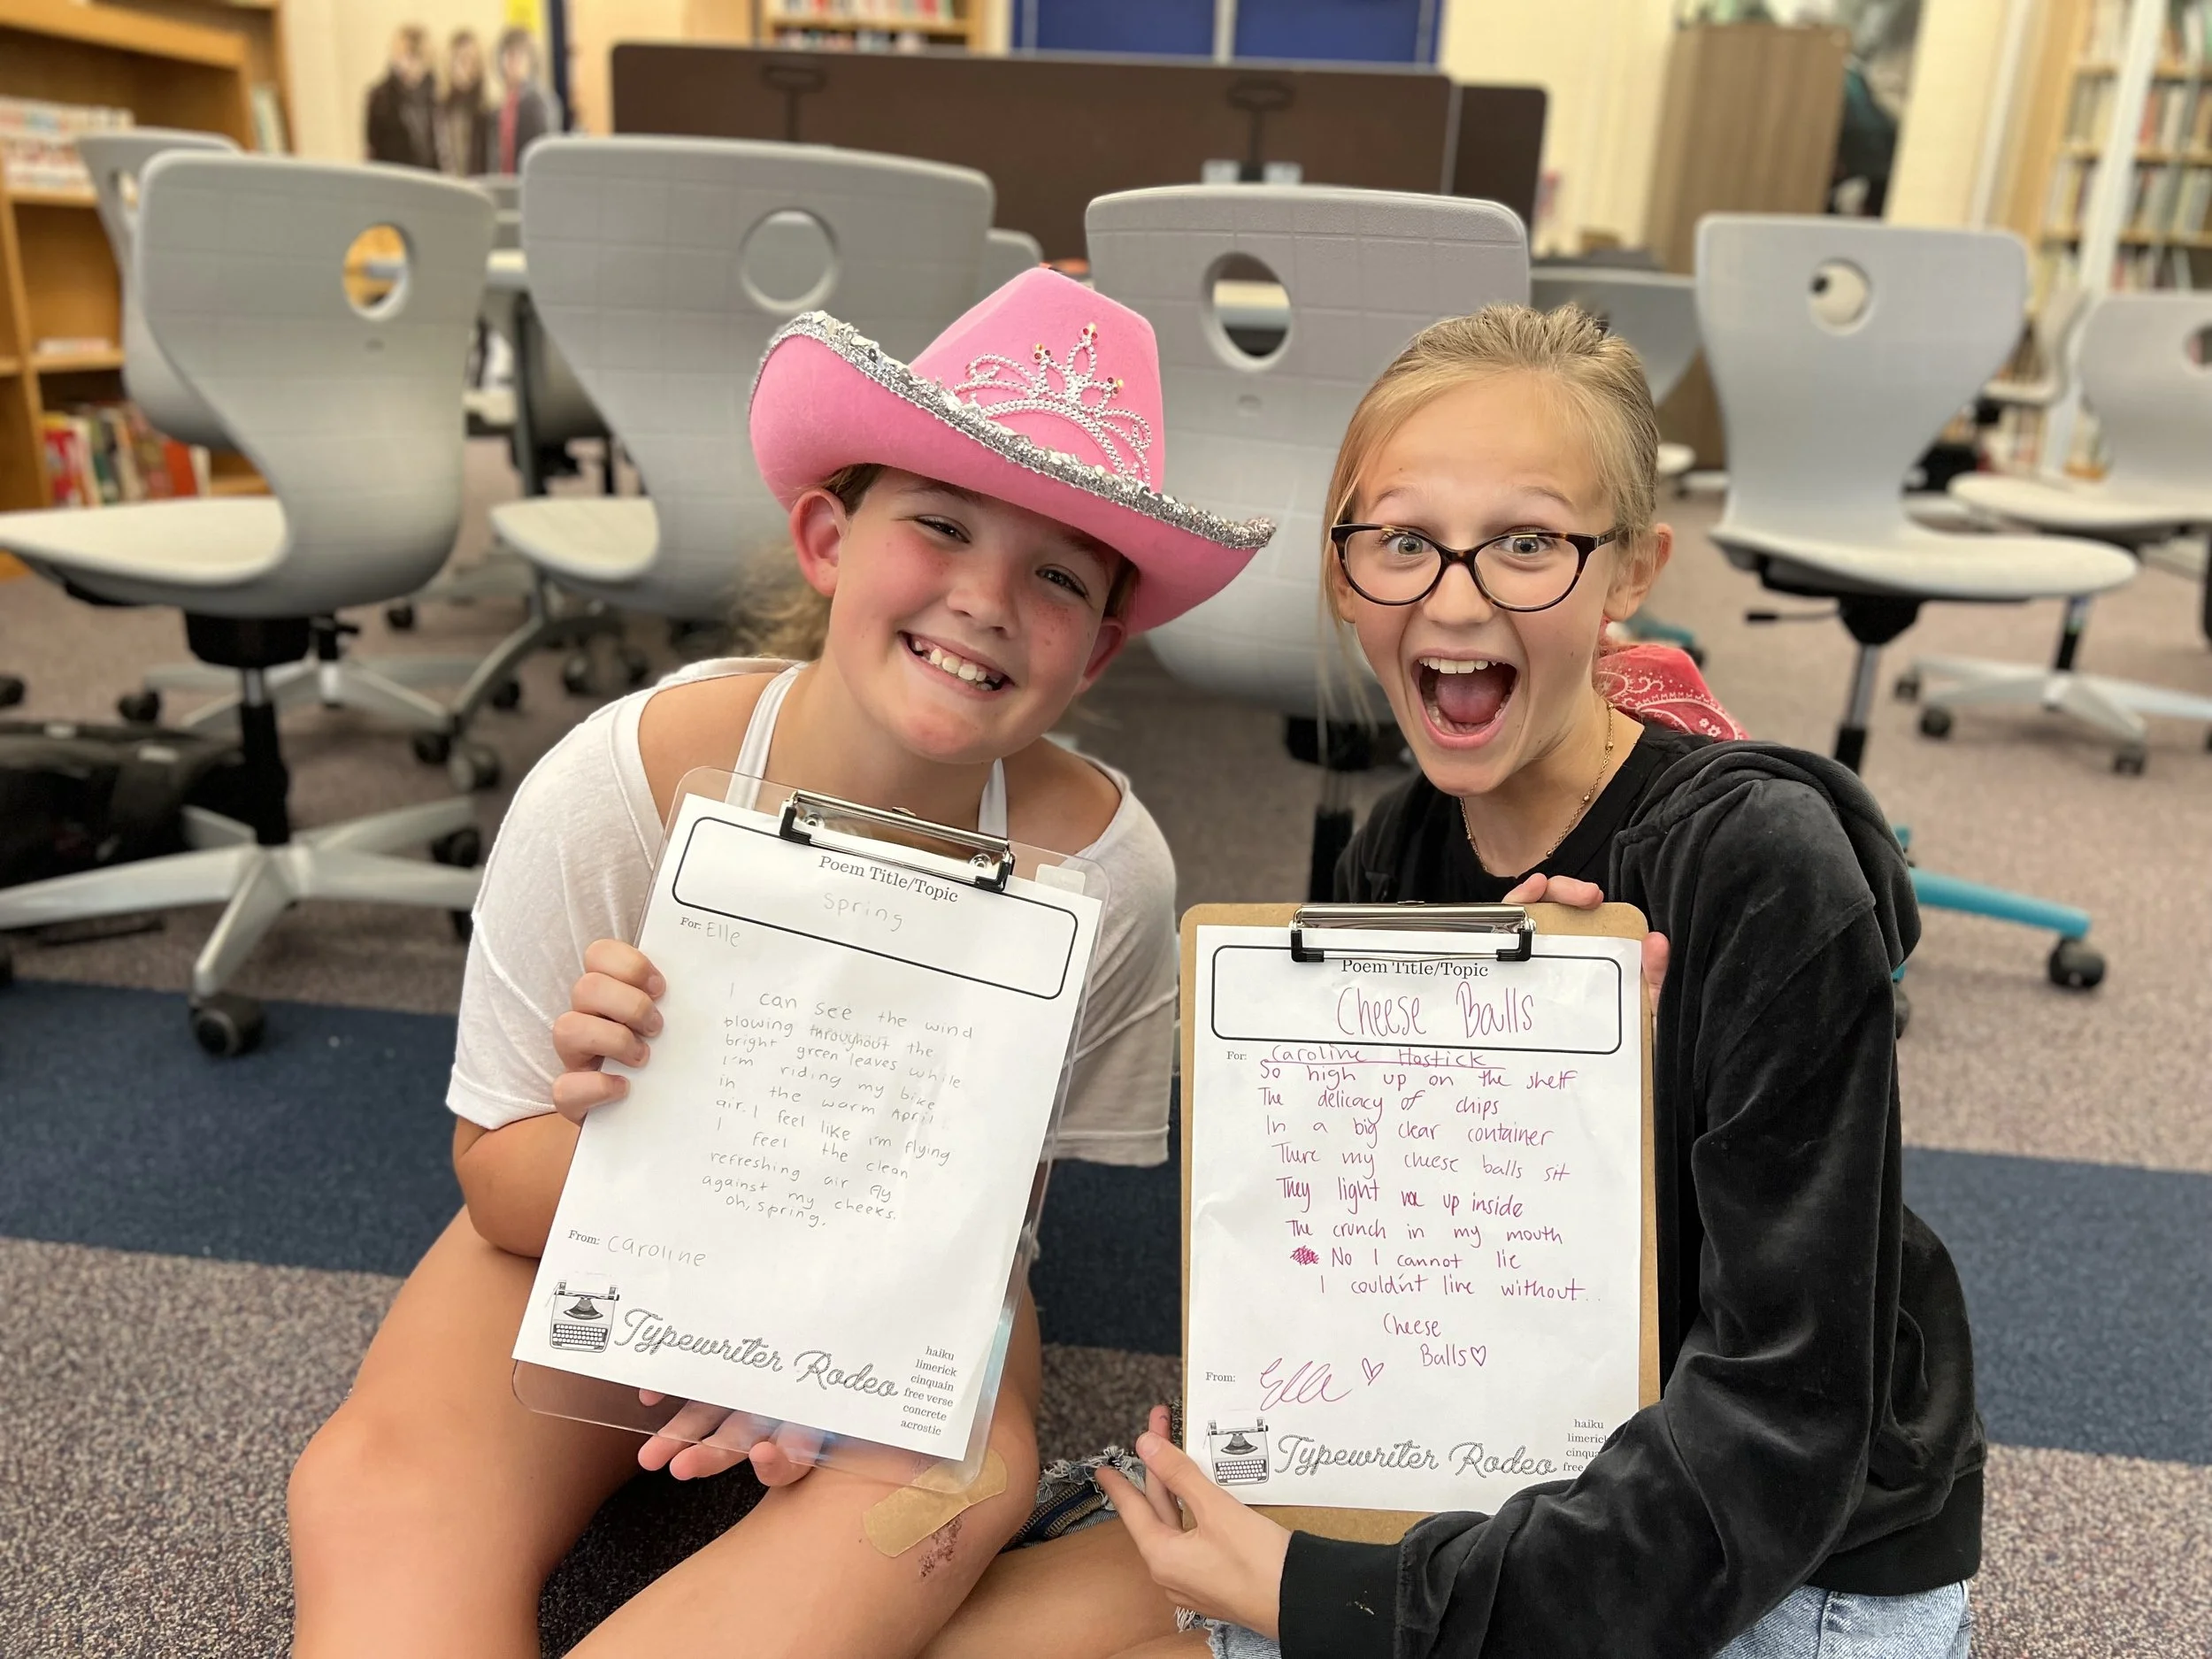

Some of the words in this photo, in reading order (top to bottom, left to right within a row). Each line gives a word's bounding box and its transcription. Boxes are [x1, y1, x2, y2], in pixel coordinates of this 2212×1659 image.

[818, 854, 865, 878] Poem
[869, 864, 960, 903] Title/Topic
[680, 917, 702, 930] For:
[706, 921, 741, 948] Elle
[1340, 959, 1388, 974] Poem
[1392, 961, 1489, 979] Title/Topic
[759, 992, 797, 1010] can
[814, 1002, 853, 1021] see
[878, 1010, 908, 1028] the
[925, 1021, 973, 1040] wind
[1336, 985, 1428, 1037] Cheese
[1455, 979, 1536, 1040] Balls
[724, 1015, 795, 1038] blowing
[809, 1024, 890, 1052] throughout
[906, 1041, 934, 1058] the
[1226, 1050, 1248, 1061] For:
[1271, 1042, 1368, 1063] Caroline
[725, 1033, 778, 1054] bright
[796, 1046, 839, 1061] green
[849, 1053, 898, 1071] leaves
[908, 1067, 962, 1089] while
[1260, 1059, 1281, 1080] So
[1306, 1065, 1357, 1091] high
[1383, 1072, 1408, 1093] up
[1428, 1073, 1455, 1087] on
[1477, 1069, 1512, 1087] the
[1525, 1070, 1578, 1090] shelf
[718, 1073, 736, 1089] in
[769, 1086, 802, 1103] the
[821, 1099, 876, 1116] warm
[891, 1108, 934, 1124] April
[780, 1065, 842, 1087] riding
[857, 1082, 885, 1099] my
[900, 1086, 936, 1111] bike
[1257, 1087, 1285, 1108] The
[1317, 1089, 1384, 1125] delicacy
[1401, 1089, 1426, 1113] of
[1455, 1096, 1501, 1118] chips
[715, 1096, 747, 1114] air.
[778, 1110, 805, 1128] feel
[820, 1120, 851, 1142] like
[904, 1139, 951, 1168] flying
[752, 1131, 787, 1148] feel
[821, 1142, 849, 1164] the
[1265, 1114, 1287, 1137] In
[1312, 1121, 1329, 1134] a
[1354, 1118, 1379, 1149] big
[1397, 1121, 1441, 1142] clear
[1467, 1123, 1555, 1148] container
[710, 1151, 802, 1183] refreshing
[824, 1175, 849, 1189] air
[869, 1183, 892, 1203] fly
[1270, 1142, 1322, 1165] There
[1341, 1153, 1377, 1179] my
[1404, 1152, 1460, 1173] cheese
[1482, 1154, 1524, 1179] balls
[1544, 1161, 1572, 1183] sit
[701, 1174, 769, 1194] against
[787, 1191, 815, 1210] my
[833, 1197, 897, 1221] cheeks.
[1276, 1175, 1312, 1213] They
[1338, 1178, 1381, 1216] light
[1443, 1193, 1460, 1217] up
[1471, 1192, 1524, 1218] inside
[567, 1229, 601, 1246] From:
[606, 1233, 707, 1269] Caroline
[1285, 1218, 1315, 1238] The
[1332, 1220, 1387, 1240] crunch
[1406, 1222, 1425, 1240] in
[1453, 1224, 1482, 1248] my
[1505, 1223, 1564, 1246] mouth
[1331, 1249, 1353, 1269] No
[1395, 1253, 1464, 1270] cannot
[1496, 1248, 1523, 1271] lie
[1443, 1272, 1476, 1295] live
[1383, 1311, 1442, 1339] Cheese
[613, 1306, 784, 1373] Typewriter
[793, 1348, 901, 1399] Rodeo
[915, 1358, 958, 1378] limerick
[925, 1345, 956, 1361] haiku
[1419, 1341, 1467, 1368] Balls
[910, 1374, 955, 1392] cinquain
[1205, 1371, 1236, 1384] From:
[902, 1404, 948, 1422] concrete
[903, 1386, 926, 1401] free
[926, 1394, 954, 1408] verse
[900, 1419, 942, 1436] acrostic
[1574, 1418, 1604, 1429] haiku
[1274, 1433, 1440, 1478] Typewriter
[1448, 1440, 1557, 1479] Rodeo
[1563, 1462, 1585, 1472] free
